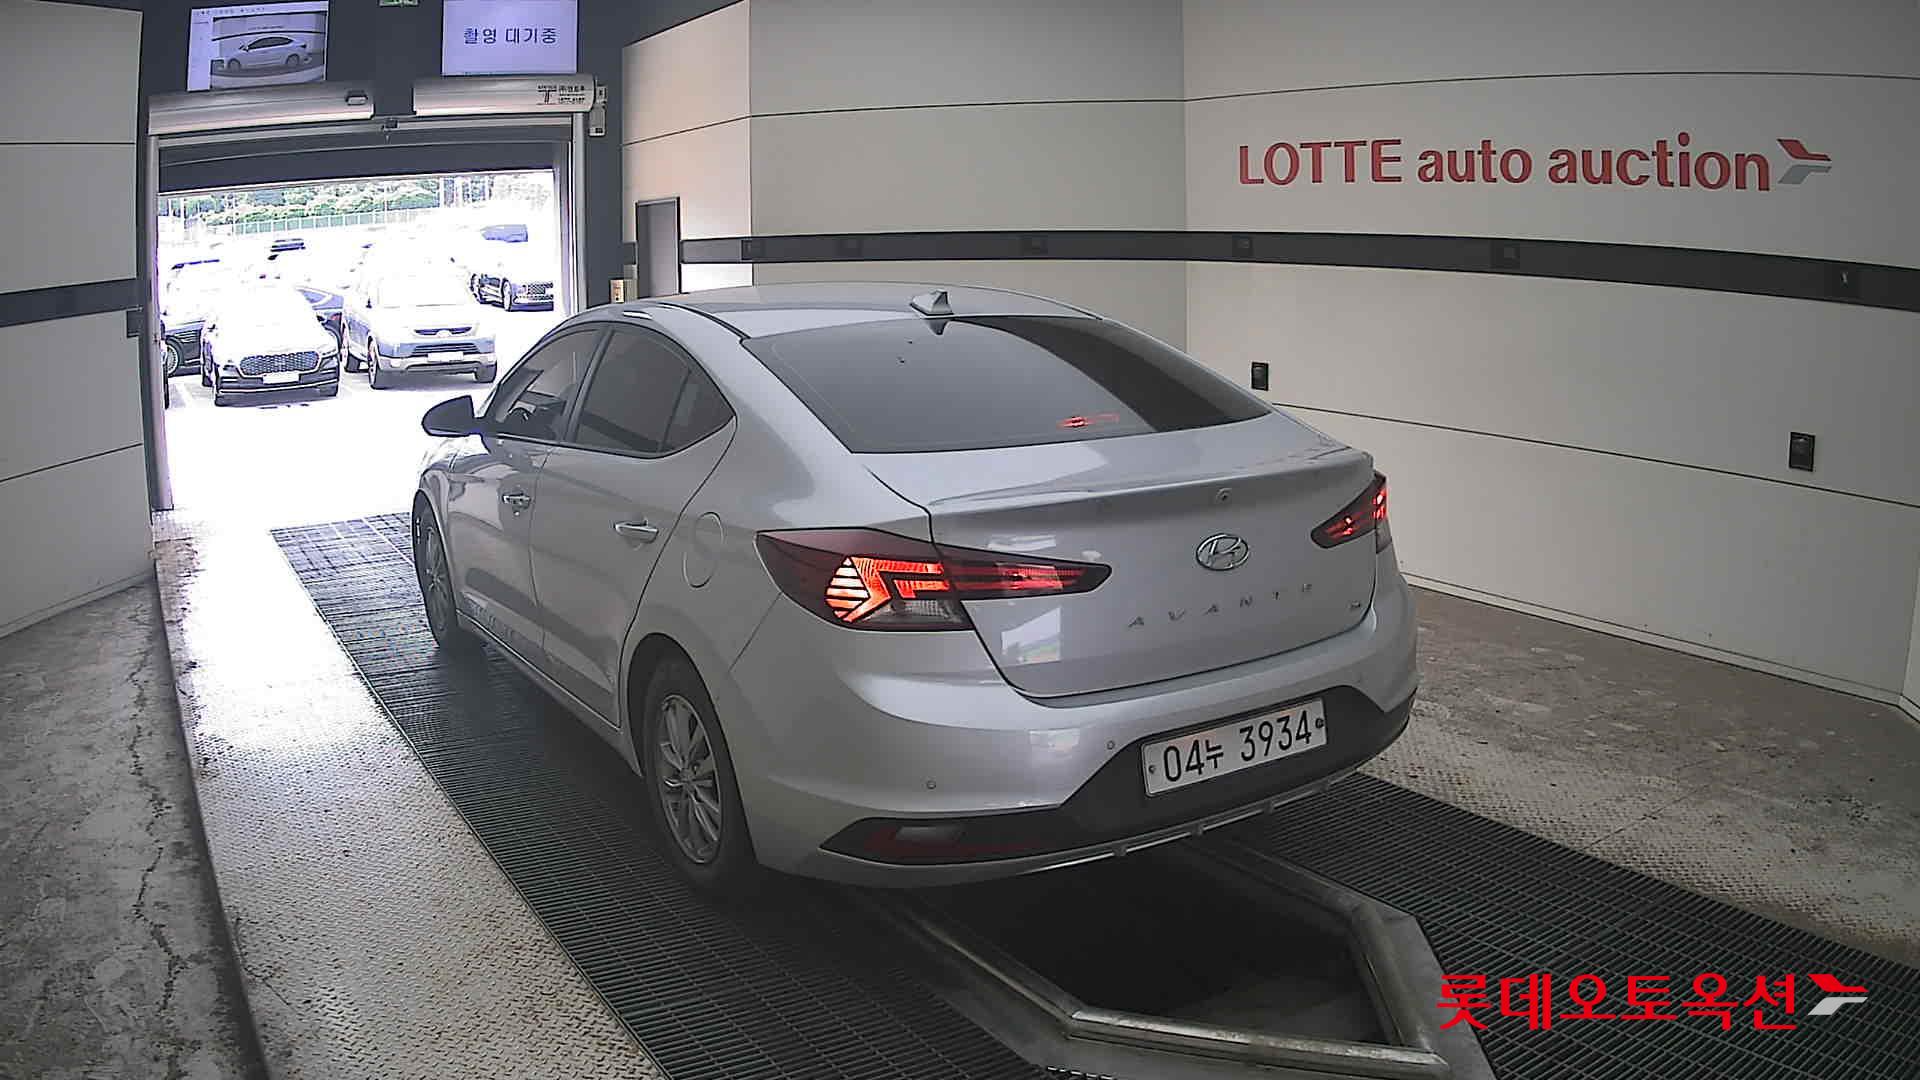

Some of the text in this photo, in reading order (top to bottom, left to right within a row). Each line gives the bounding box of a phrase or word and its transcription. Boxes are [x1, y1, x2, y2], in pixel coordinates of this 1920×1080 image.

[505, 27, 557, 44] 대기중
[1239, 131, 1771, 192] LOTTE auto auction
[1162, 710, 1312, 783] 04누 3934
